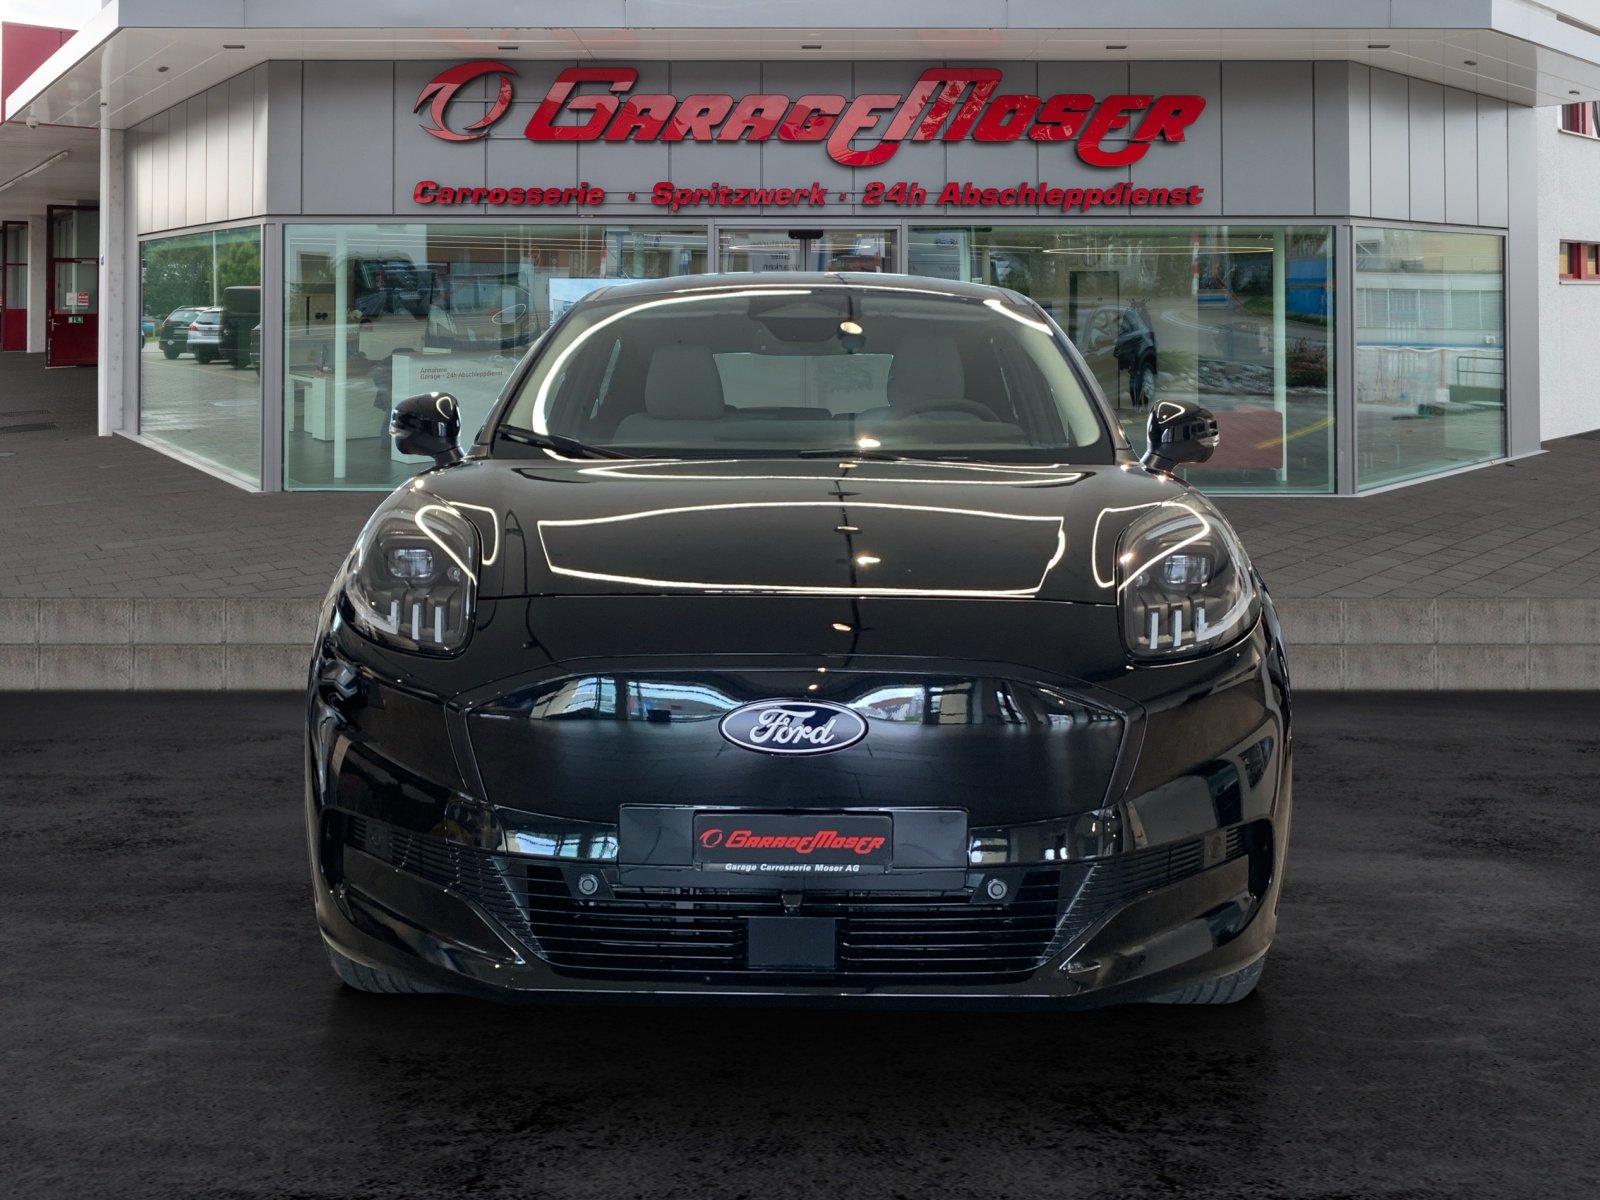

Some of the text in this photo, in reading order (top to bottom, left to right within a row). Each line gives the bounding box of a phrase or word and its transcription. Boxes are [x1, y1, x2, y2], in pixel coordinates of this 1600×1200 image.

[413, 181, 1204, 212] Carrosserie Spritzwerk 24h Abschleppdienst
[457, 371, 503, 379] Abschleppdienst
[749, 708, 835, 744] Ford
[725, 863, 860, 872] Garage Carrosserie Moser AG
